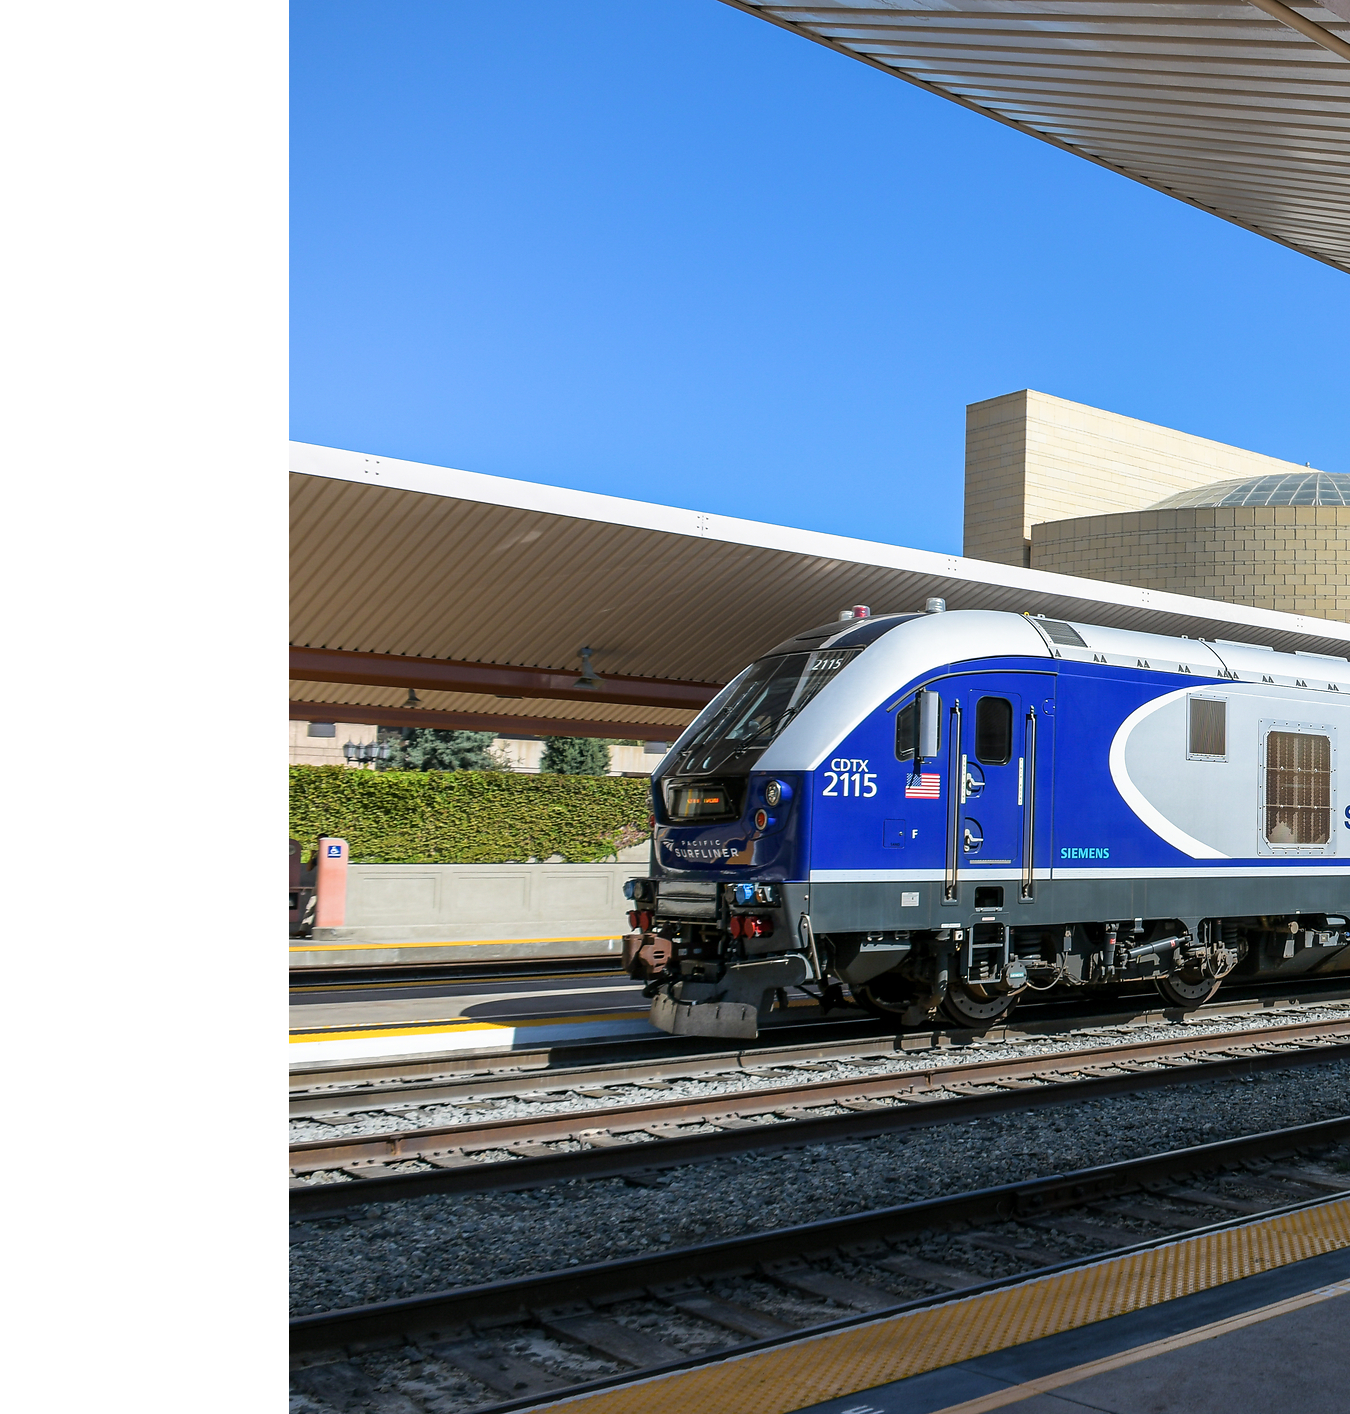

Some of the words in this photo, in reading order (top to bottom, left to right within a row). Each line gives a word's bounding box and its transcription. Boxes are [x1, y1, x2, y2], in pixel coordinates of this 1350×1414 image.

[811, 658, 844, 670] 2115
[831, 758, 869, 772] CDTX
[822, 771, 878, 798] 2115
[912, 829, 919, 839] F
[681, 839, 721, 847] PACIFIC
[674, 847, 739, 859] SURFLINER
[1060, 847, 1110, 859] SIEMENS
